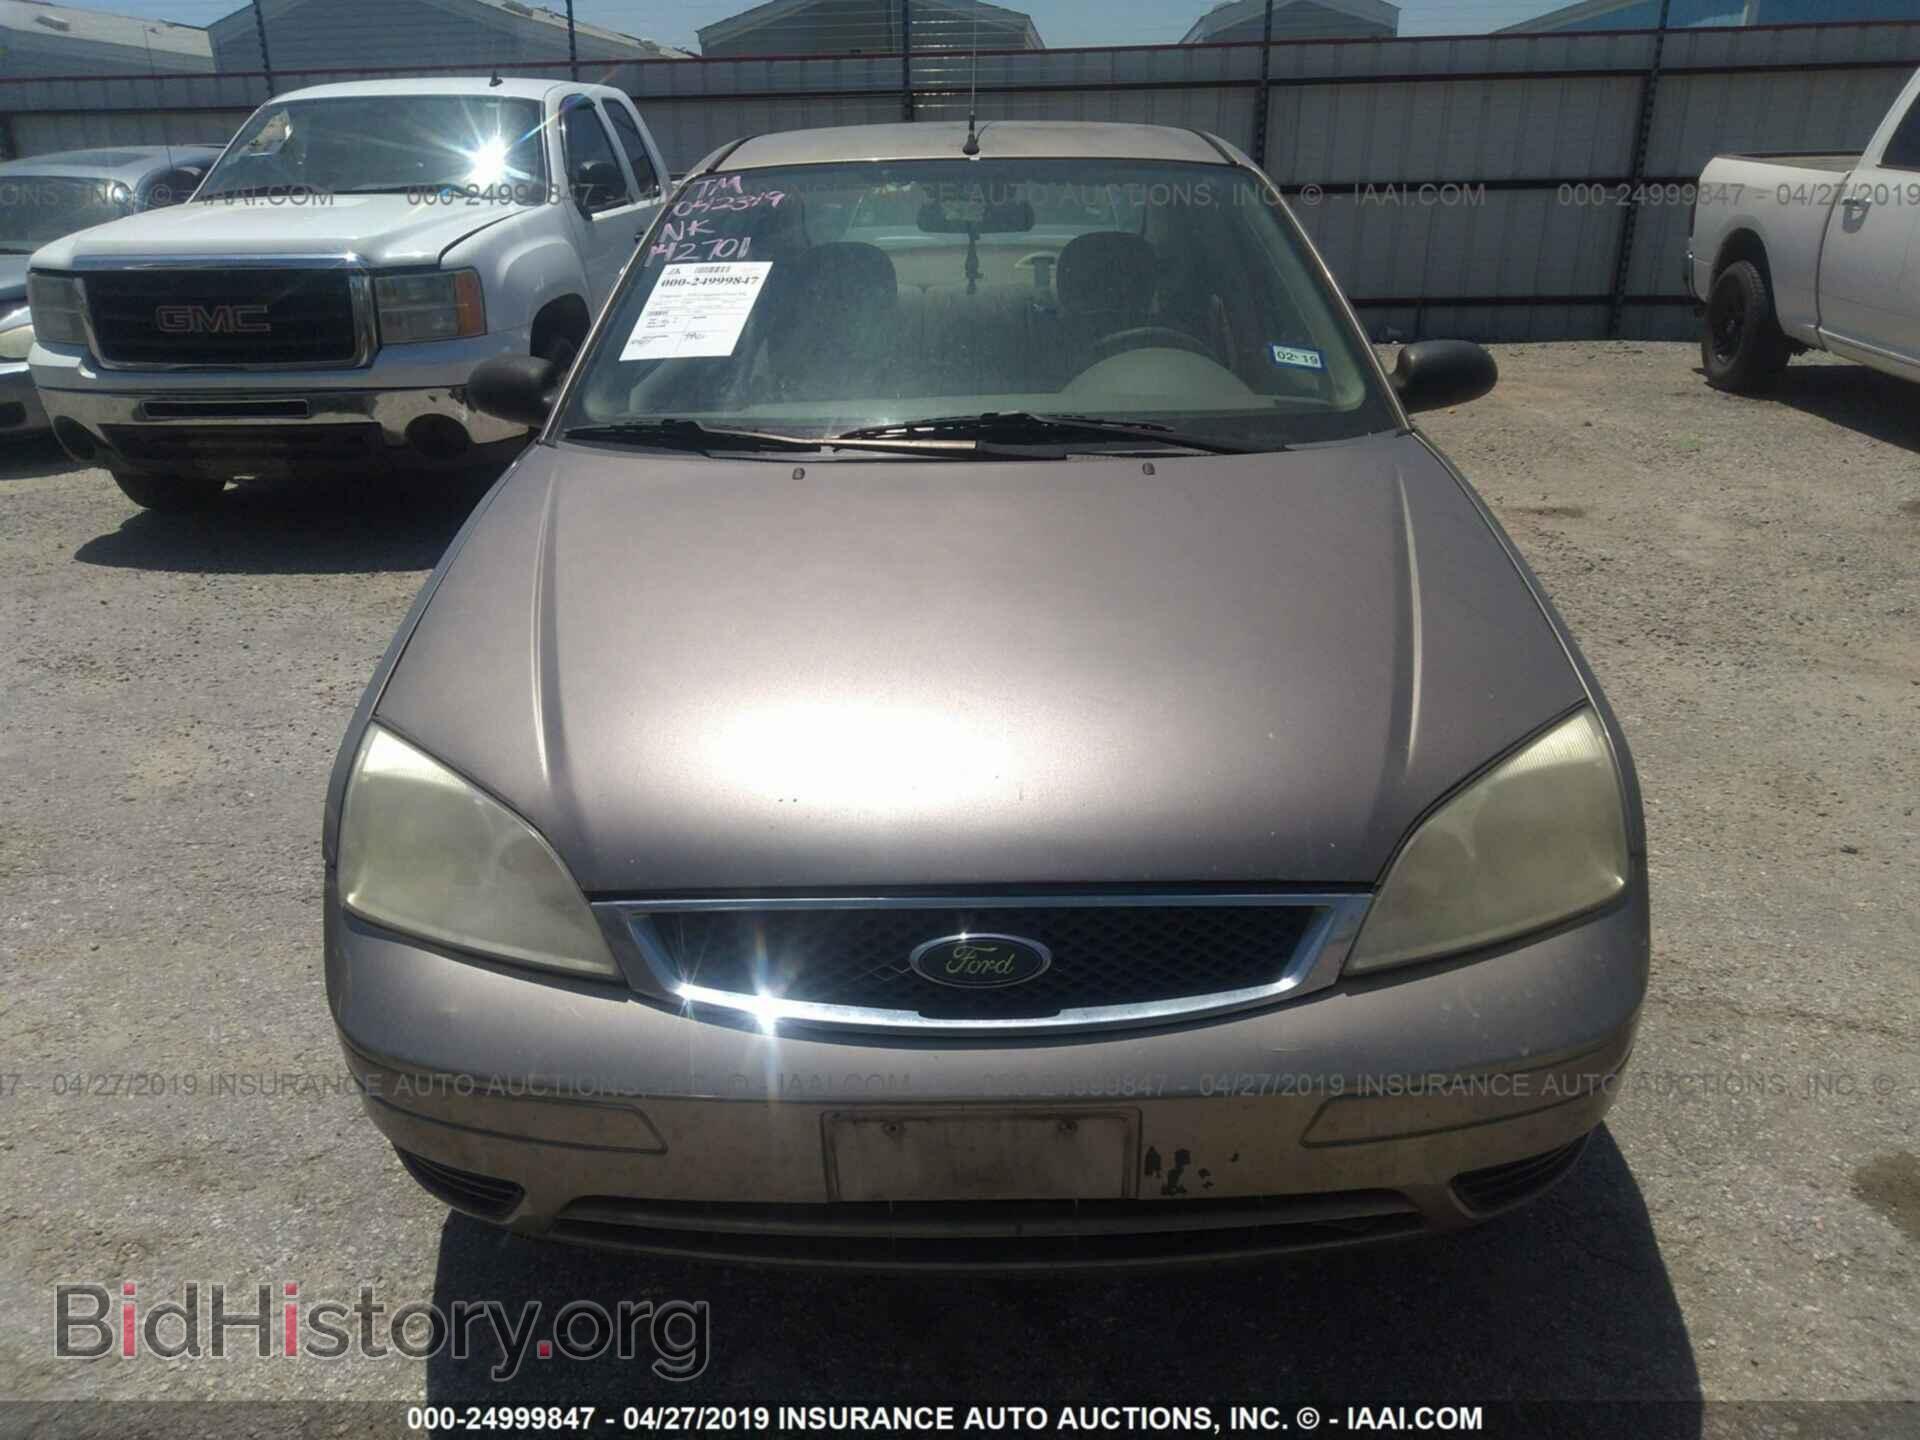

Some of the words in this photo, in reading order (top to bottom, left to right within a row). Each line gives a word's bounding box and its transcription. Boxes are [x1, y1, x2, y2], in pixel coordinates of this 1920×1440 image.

[661, 275, 760, 288] 000-24999847
[156, 304, 271, 332] GMC
[945, 945, 1015, 974] Ford
